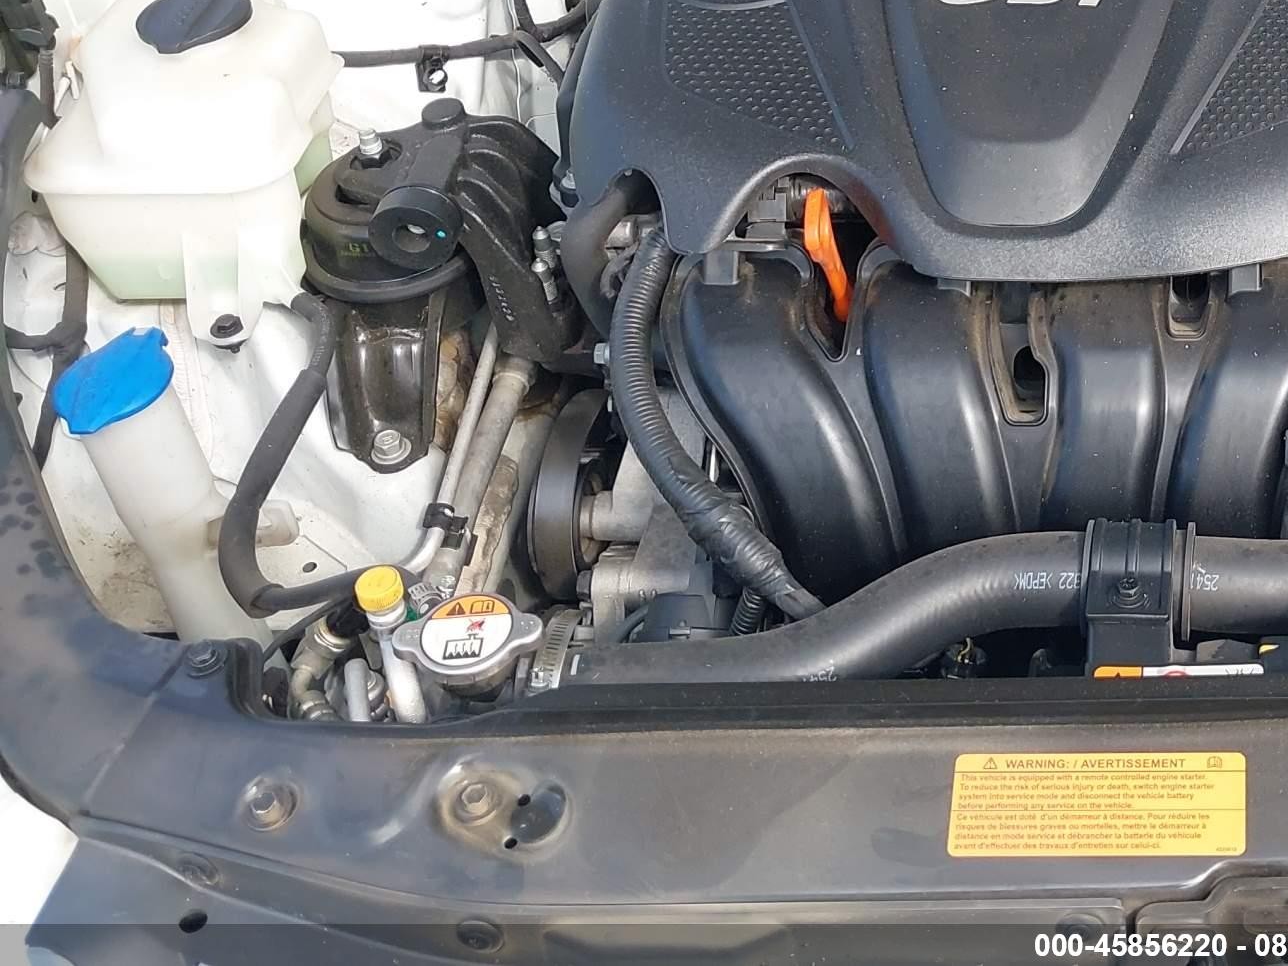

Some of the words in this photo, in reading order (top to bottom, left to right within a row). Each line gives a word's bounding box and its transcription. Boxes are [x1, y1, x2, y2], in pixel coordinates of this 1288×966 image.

[1005, 759, 1070, 769] WARNING:
[1080, 758, 1186, 769] AVERTISSEMENT
[961, 773, 977, 781] This
[979, 773, 1006, 781] vehicle
[1018, 773, 1055, 783] equipped
[1057, 773, 1073, 781] with
[1081, 773, 1109, 781] remote
[1111, 773, 1150, 781] controlled
[1152, 773, 1178, 782] engine
[971, 783, 998, 791] reduce
[1000, 783, 1013, 791] the
[1014, 783, 1028, 791] risk
[1072, 783, 1094, 792] injury
[1107, 783, 1132, 792] death,
[1161, 783, 1188, 792] engine
[960, 793, 987, 802] system
[1077, 792, 1120, 800] disconnect
[1122, 792, 1136, 800] the
[1138, 792, 1165, 800] vehicle
[1167, 792, 1194, 801] battery
[985, 802, 1028, 811] performing
[1031, 802, 1044, 811] any
[1090, 801, 1102, 809] the
[1110, 812, 1146, 820] distance.
[1148, 812, 1166, 820] Pour
[1198, 812, 1210, 820] les
[956, 823, 984, 832] risques
[1000, 822, 1038, 830] blessures
[1040, 822, 1066, 832] graves
[1081, 822, 1120, 831] mortelles,
[1158, 821, 1200, 829] démarreur
[955, 832, 988, 840] distance
[1002, 832, 1024, 840] mode
[1067, 832, 1114, 840] débrancher
[1124, 831, 1154, 839] batterie
[954, 841, 976, 849] avant
[1022, 841, 1037, 849] des
[1039, 841, 1069, 849] travaux
